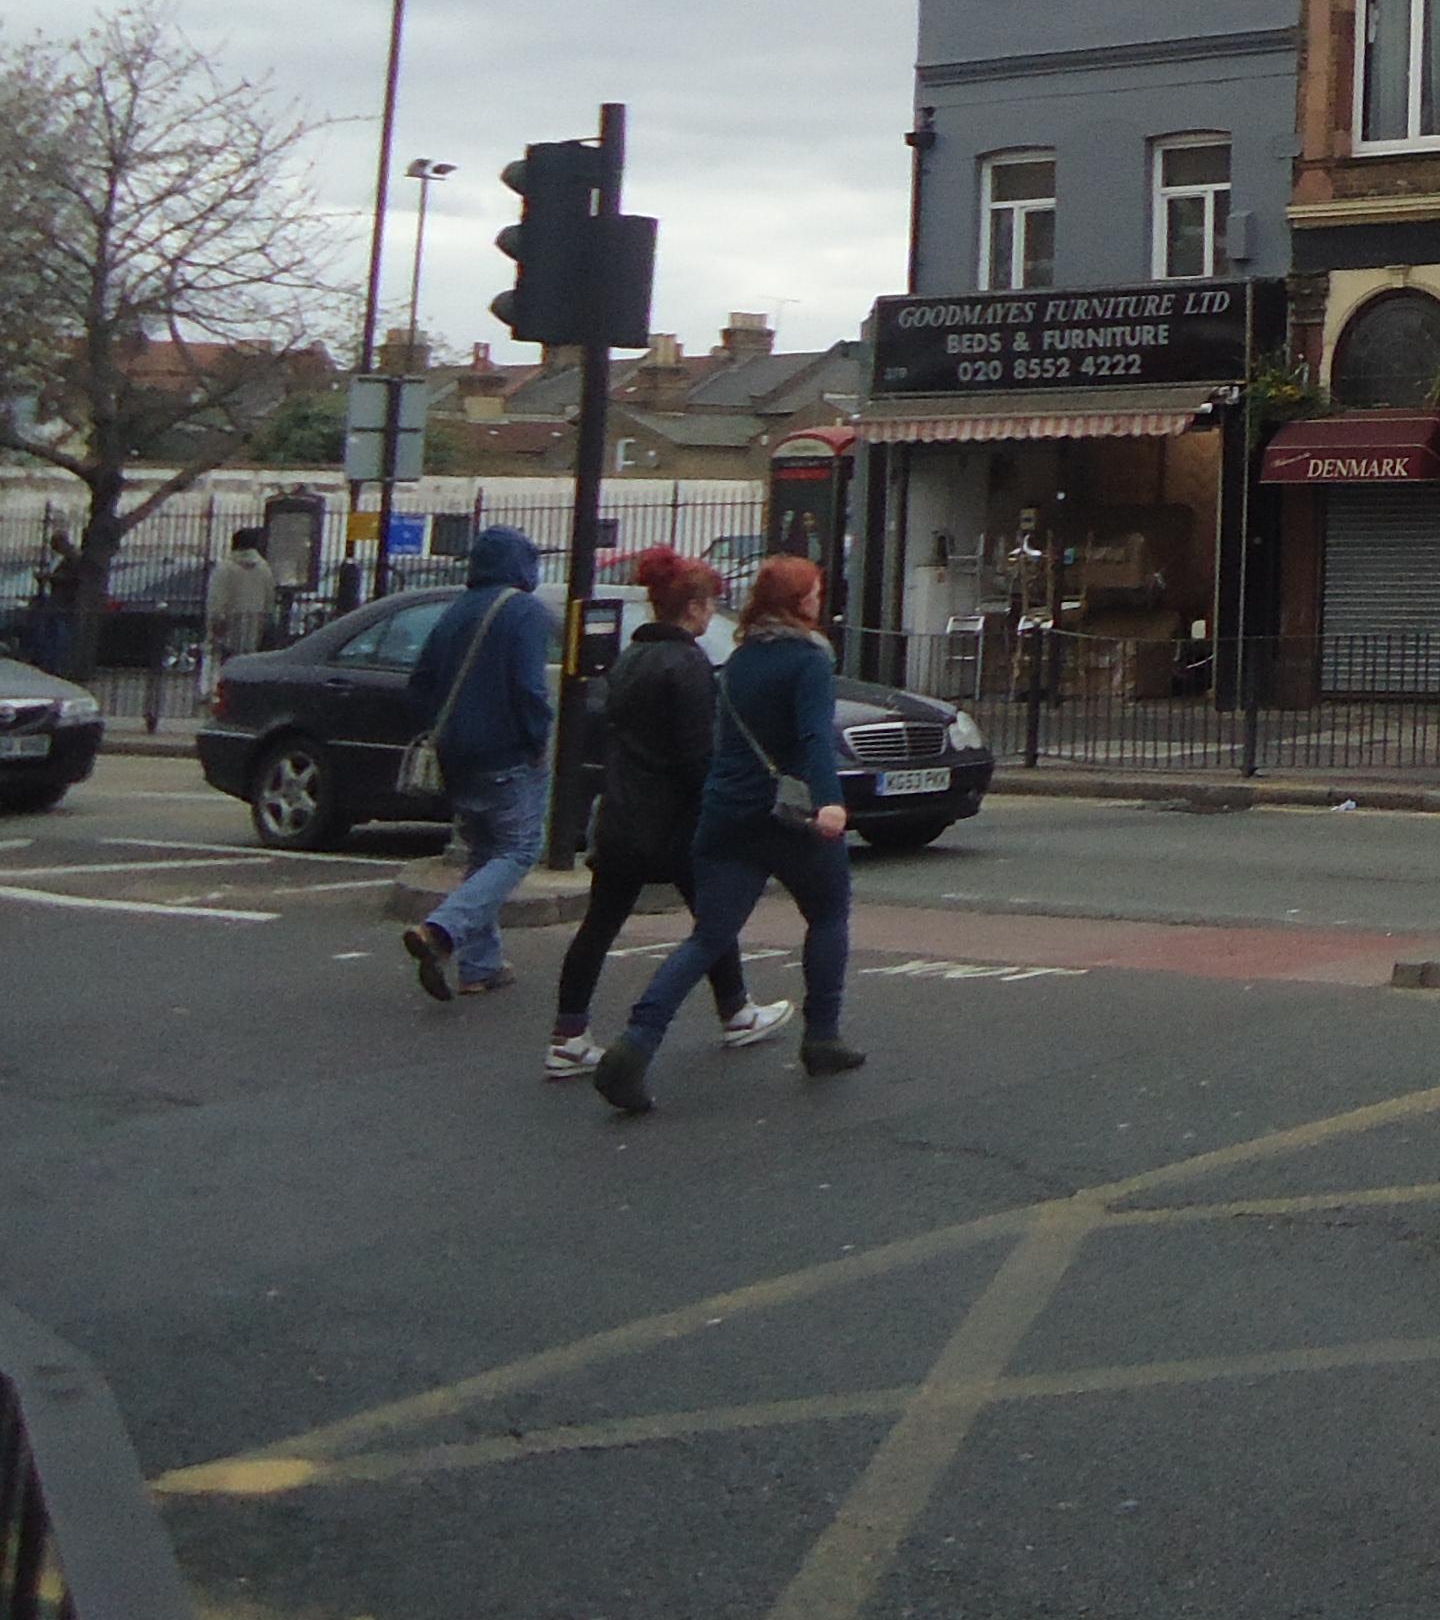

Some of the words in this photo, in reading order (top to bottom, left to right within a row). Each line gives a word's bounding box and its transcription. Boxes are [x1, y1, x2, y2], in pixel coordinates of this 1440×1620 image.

[899, 300, 1035, 329] GOODMAYES
[1043, 293, 1175, 323] FURNITURE
[1183, 291, 1231, 315] LTD
[946, 331, 1001, 354] BEDS
[1012, 331, 1030, 352] &
[1042, 324, 1170, 351] FURNITURE
[957, 360, 1000, 381] 020
[1012, 357, 1071, 380] 8552
[1081, 353, 1142, 376] 4222
[1307, 457, 1410, 478] DENMARK
